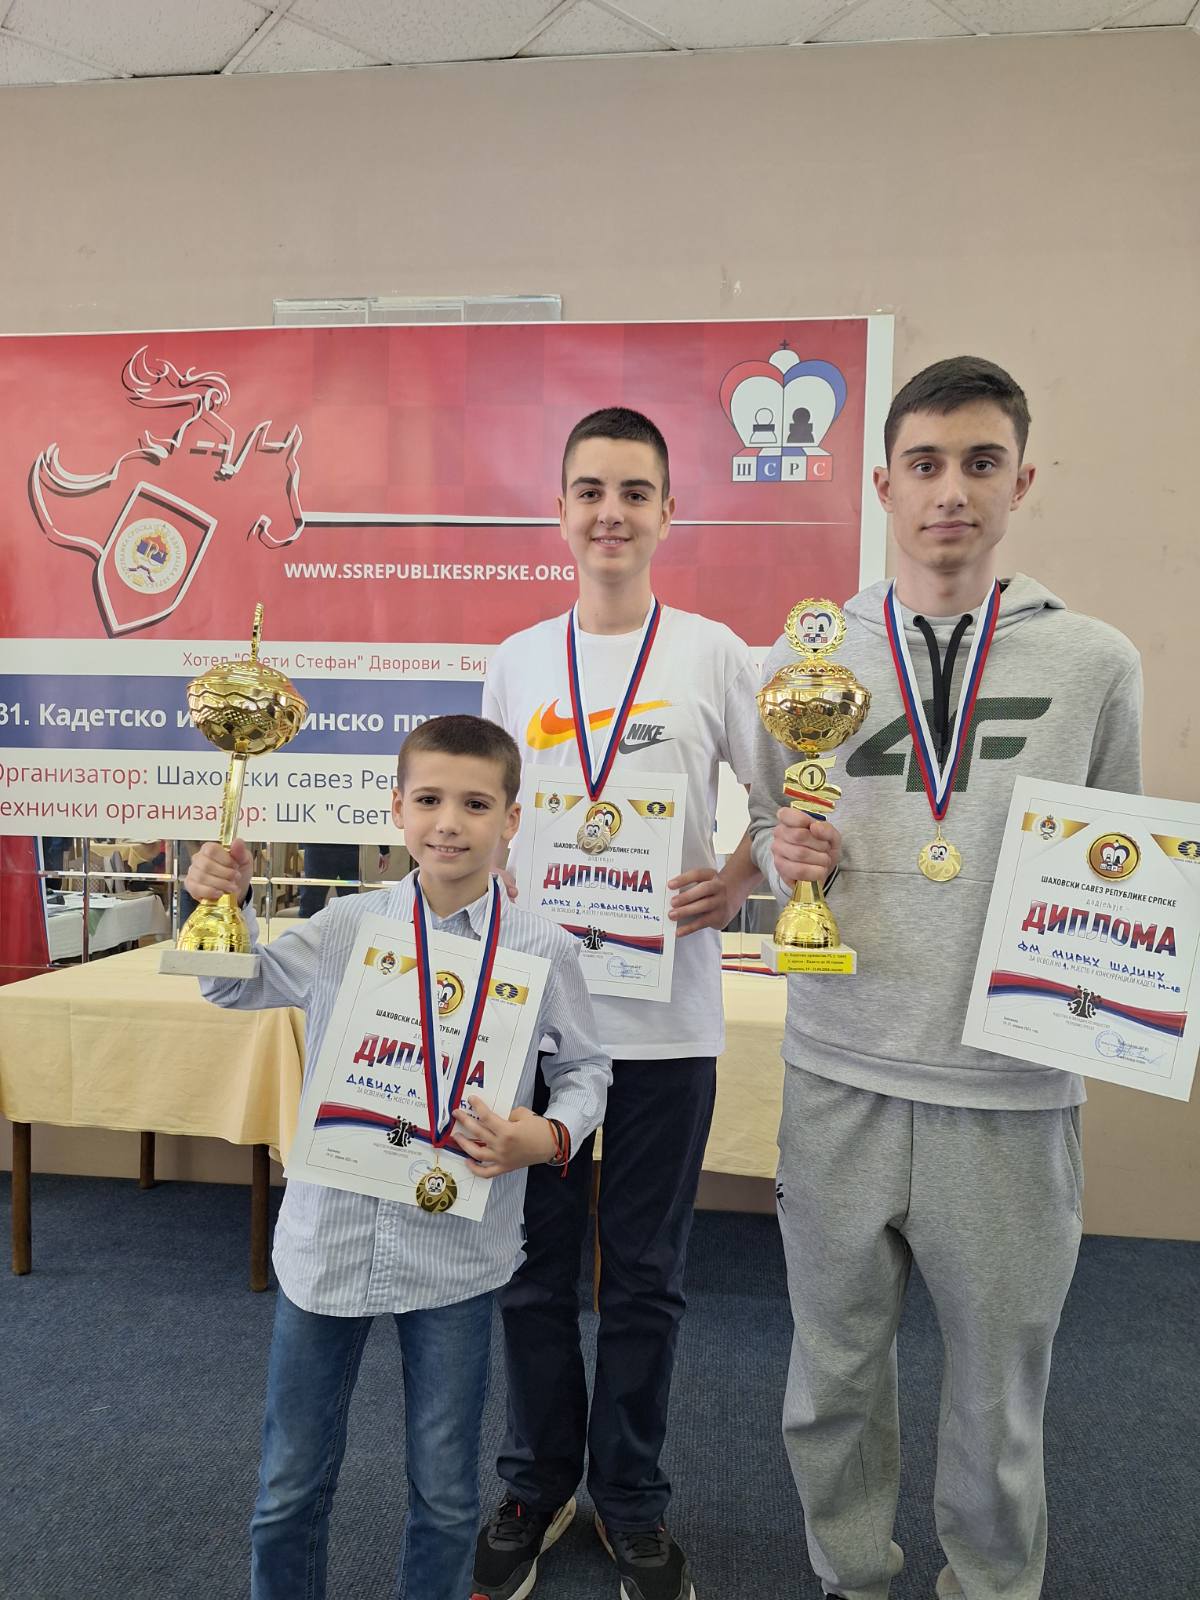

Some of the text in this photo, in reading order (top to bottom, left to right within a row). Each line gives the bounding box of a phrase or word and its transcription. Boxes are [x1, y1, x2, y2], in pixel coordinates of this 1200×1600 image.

[284, 563, 576, 581] WWW.SSREPUBLIKESRPSKE.ORG
[234, 653, 289, 668] "Сети
[295, 654, 364, 671] Стефан"
[369, 655, 441, 673] Дворови
[39, 703, 167, 732] Кадетско
[297, 712, 384, 735] инско
[626, 723, 666, 742] NIKE
[0, 763, 148, 790] рганизатор:
[287, 771, 353, 789] савез
[807, 770, 816, 786] 1
[0, 801, 98, 818] ехнички
[106, 803, 266, 828] организар:
[276, 803, 317, 823] ШК
[606, 846, 629, 854] УБЛИКЕ
[543, 863, 654, 893] ДИПЛОМА
[1041, 875, 1177, 908] ШАХОВСКИ САВЕЗ РЕПУБЛИКЕ СРПСКЕ
[1021, 900, 1177, 957] ДИПЛОМА
[1052, 949, 1100, 967] МИРКУ
[376, 1009, 410, 1024] ШАХОВСКИ
[346, 1074, 401, 1094] ДАВИДУ
